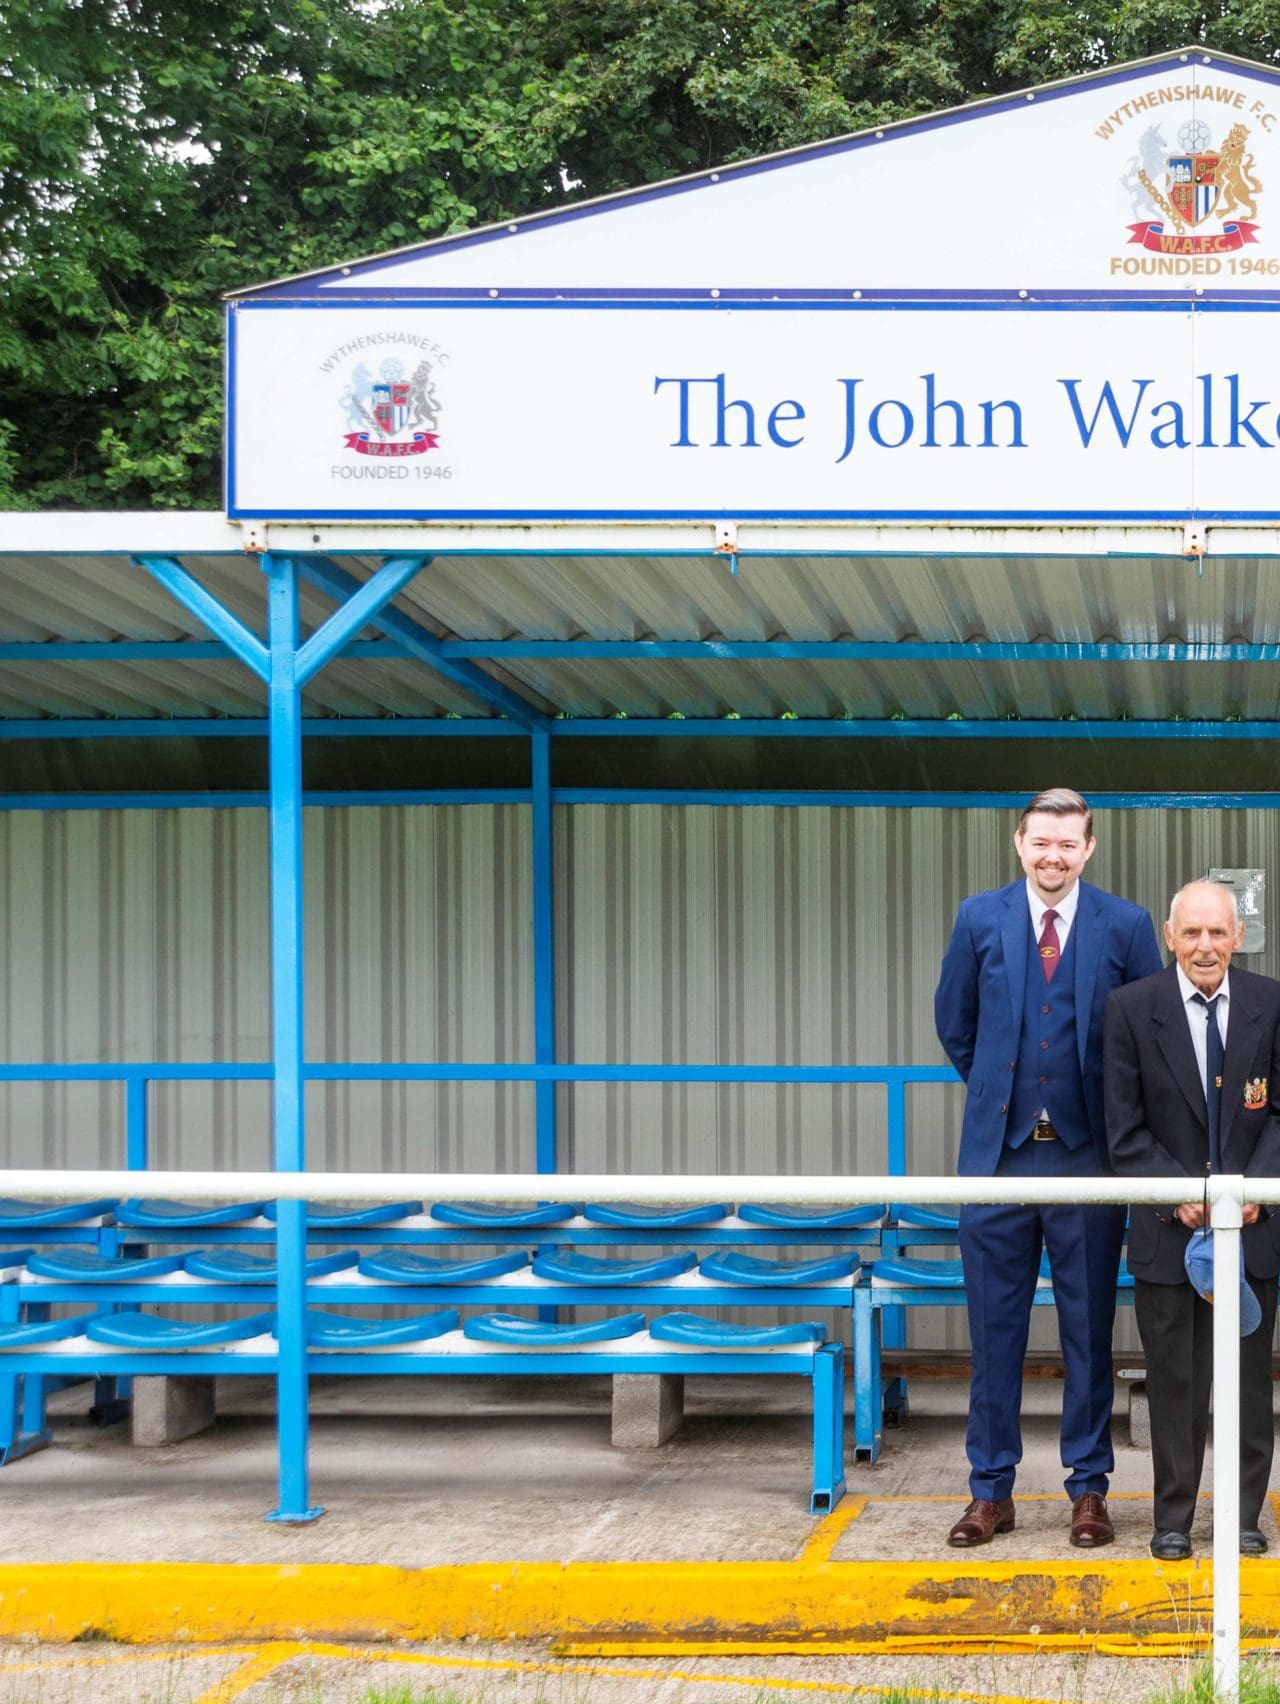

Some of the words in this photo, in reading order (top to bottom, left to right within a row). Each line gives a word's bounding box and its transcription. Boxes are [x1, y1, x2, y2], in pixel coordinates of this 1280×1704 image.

[1094, 84, 1247, 142] WYTHENSHAWE
[1249, 100, 1278, 133] F.C.
[1159, 234, 1233, 254] W.A.F.C.
[1110, 257, 1222, 276] FOUNDED
[1227, 257, 1280, 276] 1946
[319, 332, 430, 374] WYTHENSHAWE
[654, 373, 806, 449] The
[835, 373, 1029, 464] John
[331, 465, 410, 480] FOUNDED
[415, 465, 453, 480] 1946
